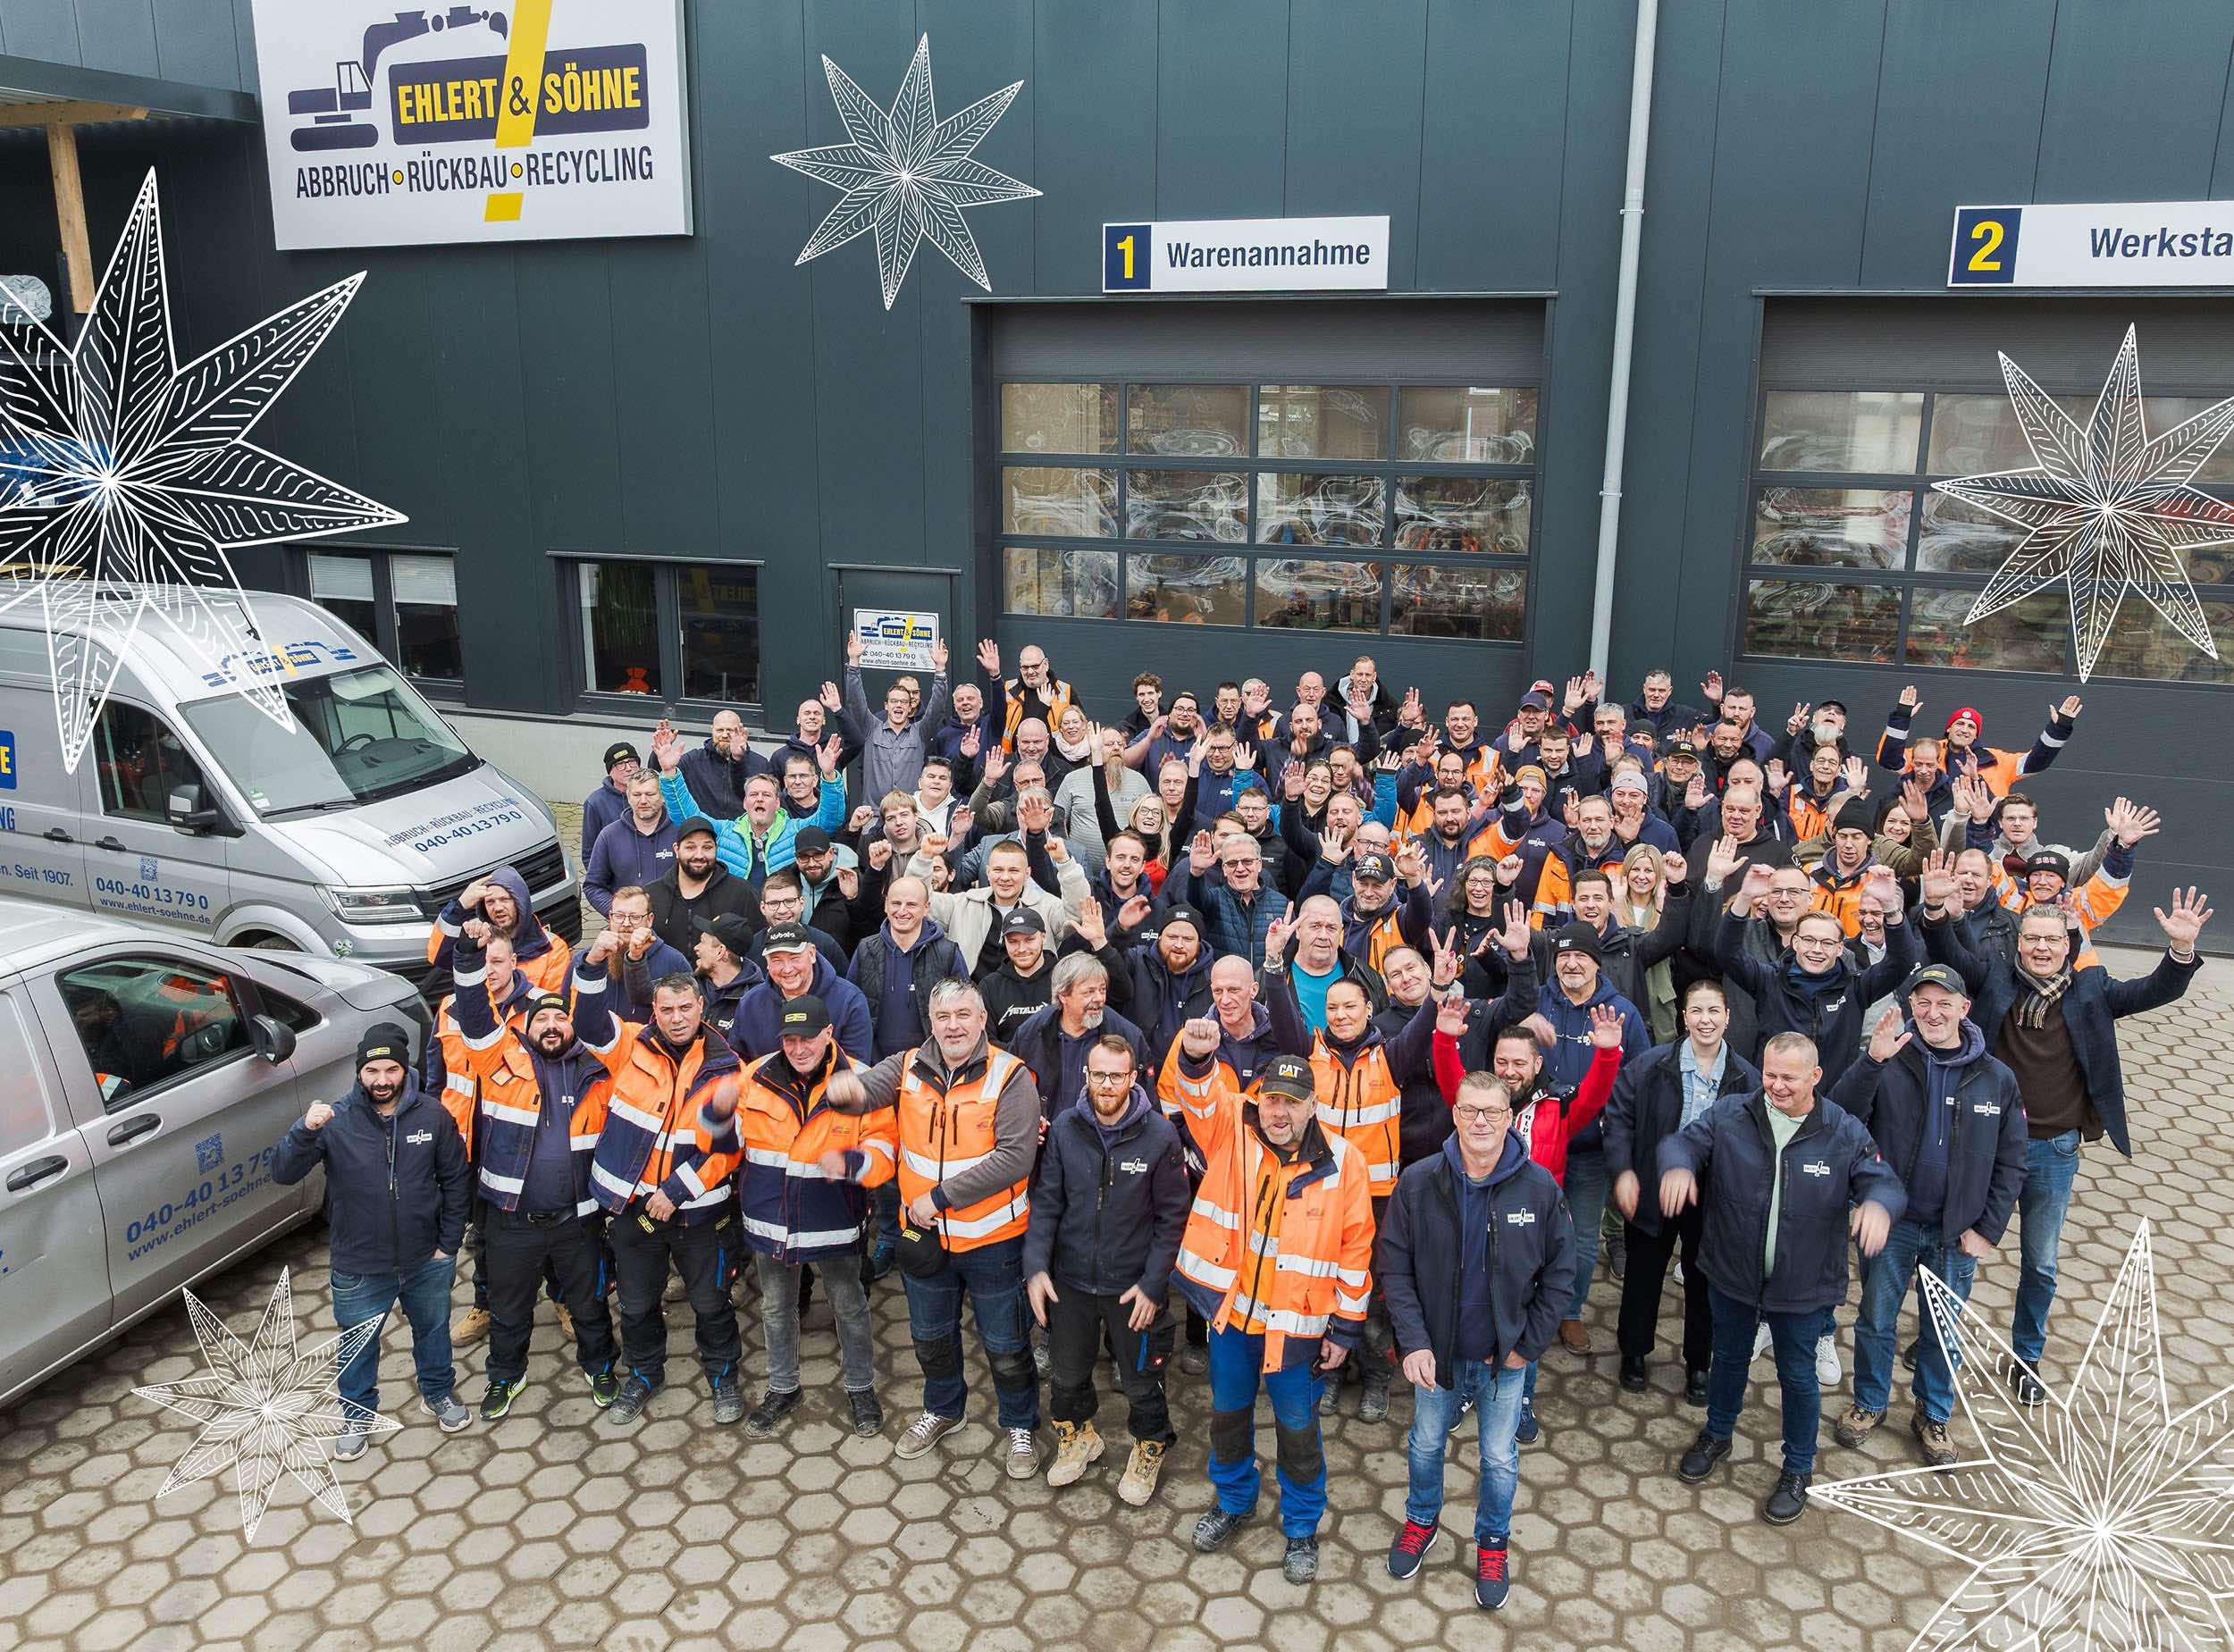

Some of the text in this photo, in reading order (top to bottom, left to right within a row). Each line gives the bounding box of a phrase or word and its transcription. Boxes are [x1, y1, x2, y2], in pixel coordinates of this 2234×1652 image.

[398, 63, 642, 124] EHLERT & SÖHNE
[297, 146, 653, 198] ABBRUCH RÜCKBAU RECYCLING
[1117, 236, 1370, 279] 1 Warenannahme
[1968, 221, 2233, 272] 2 Werksta
[415, 826, 472, 852] 040-40
[14, 864, 38, 880] Seit
[43, 869, 73, 886] 1907.
[97, 877, 150, 900] 040-40
[99, 898, 211, 924] www.ehlert-soehne.de
[1279, 1064, 1303, 1078] CAT
[127, 1181, 213, 1243] 040-40
